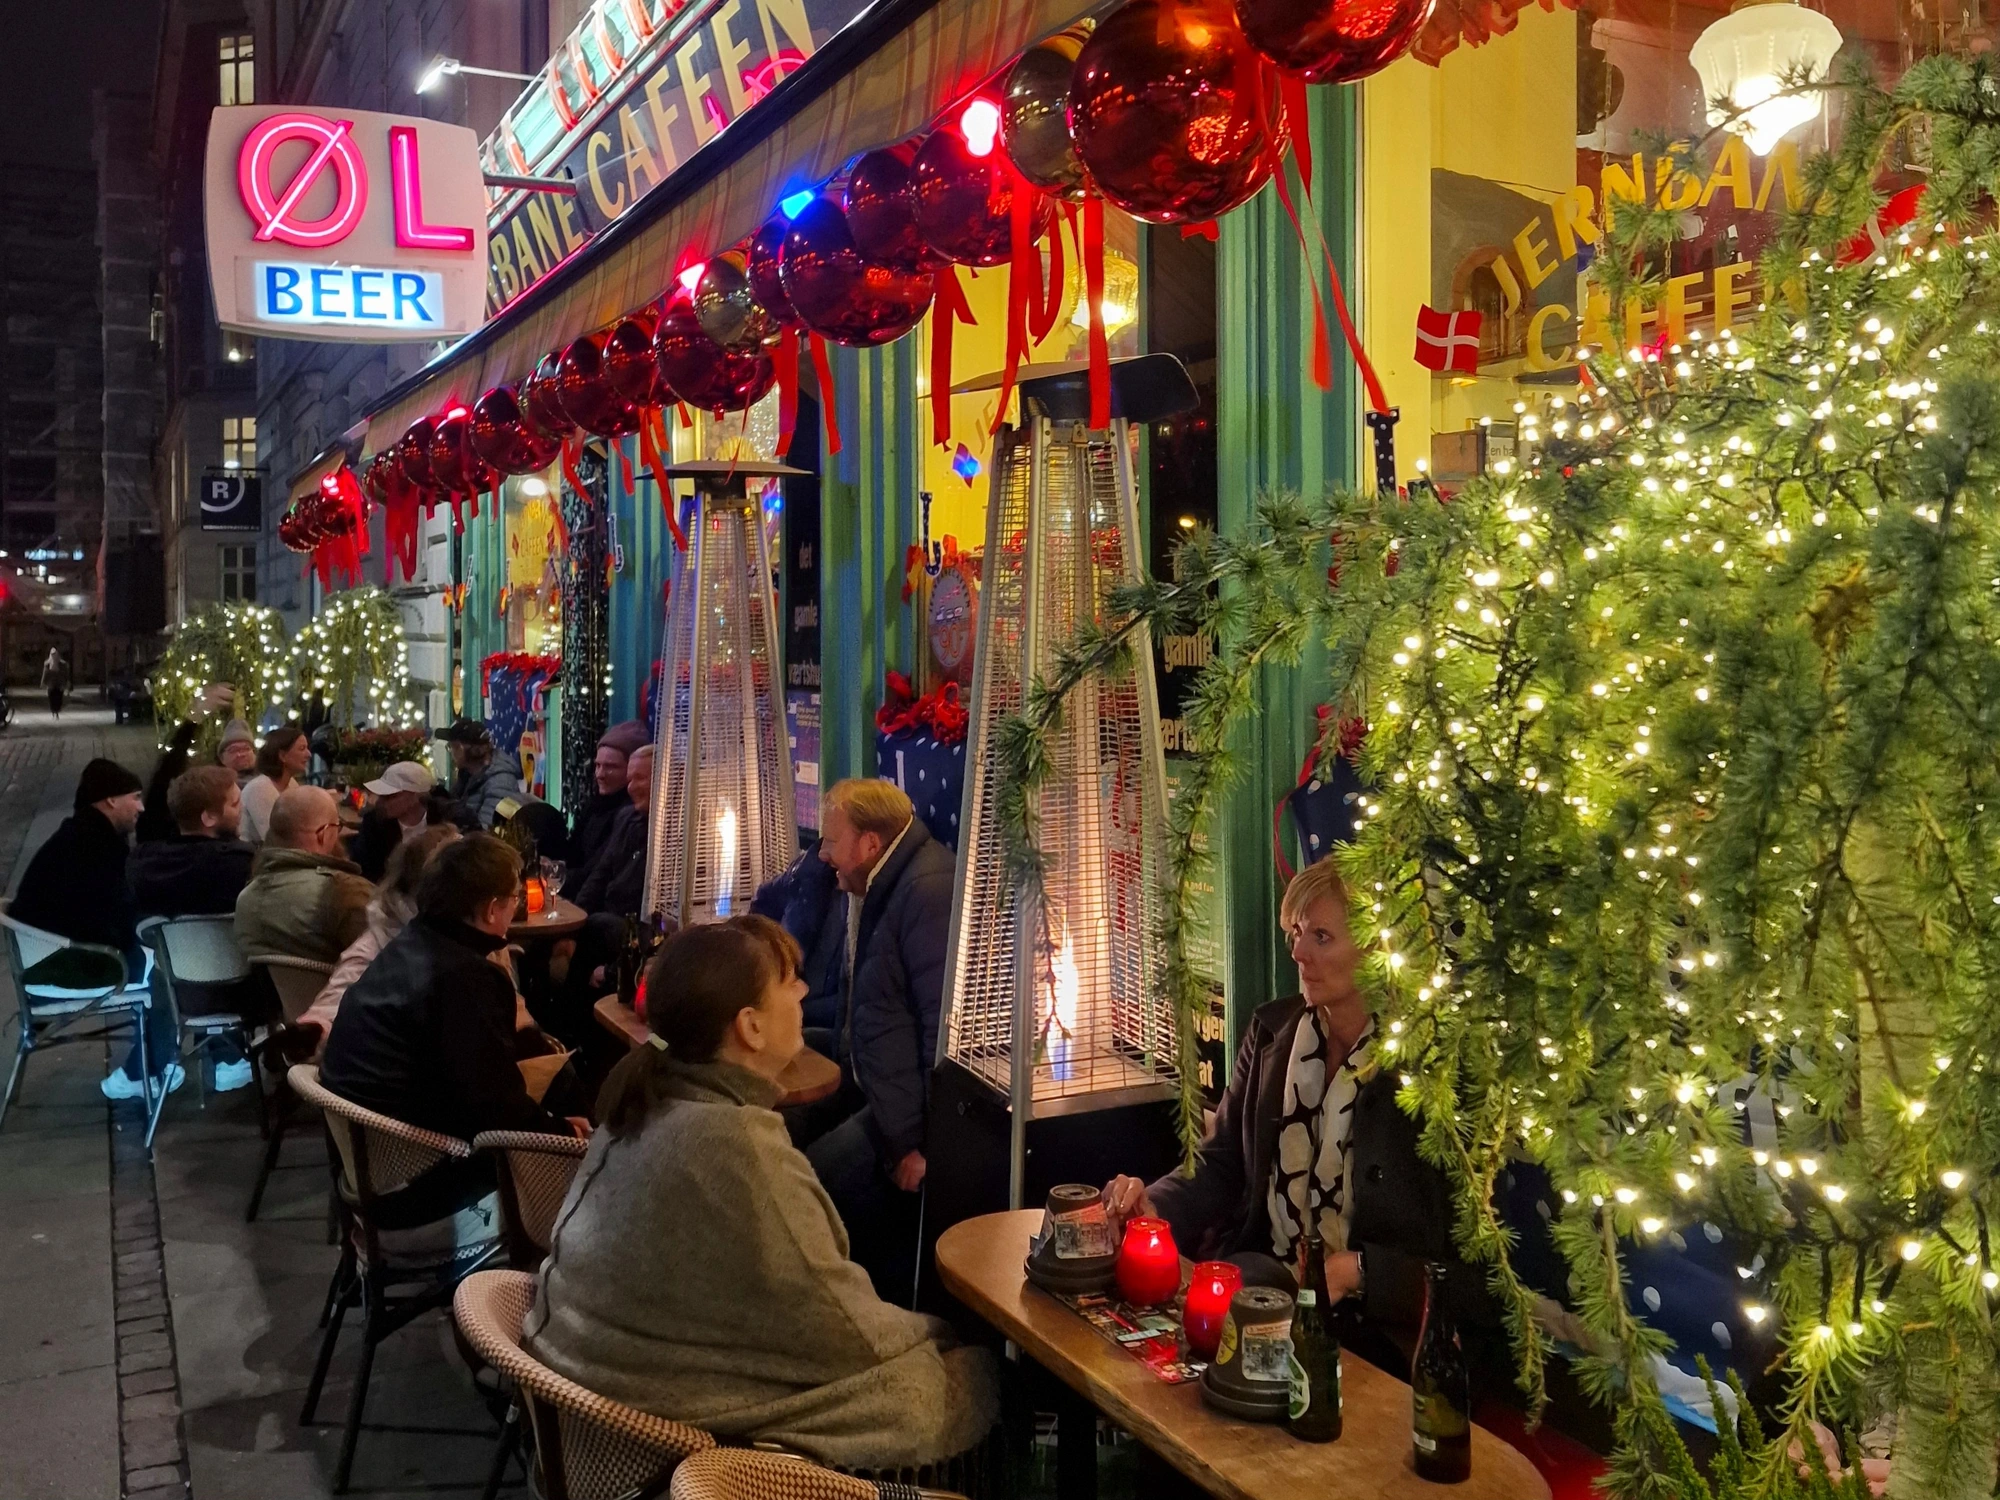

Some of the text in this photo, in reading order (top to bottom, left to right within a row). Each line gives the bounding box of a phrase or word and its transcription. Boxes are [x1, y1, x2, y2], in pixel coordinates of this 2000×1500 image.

[587, 0, 816, 220] CAFEEN
[237, 112, 475, 251] ØL
[1491, 135, 1832, 319] JERNBAN
[265, 265, 433, 322] BEER
[211, 480, 229, 499] R
[795, 600, 818, 632] gamle
[788, 659, 822, 686] værtshu
[1164, 626, 1215, 673] gamle
